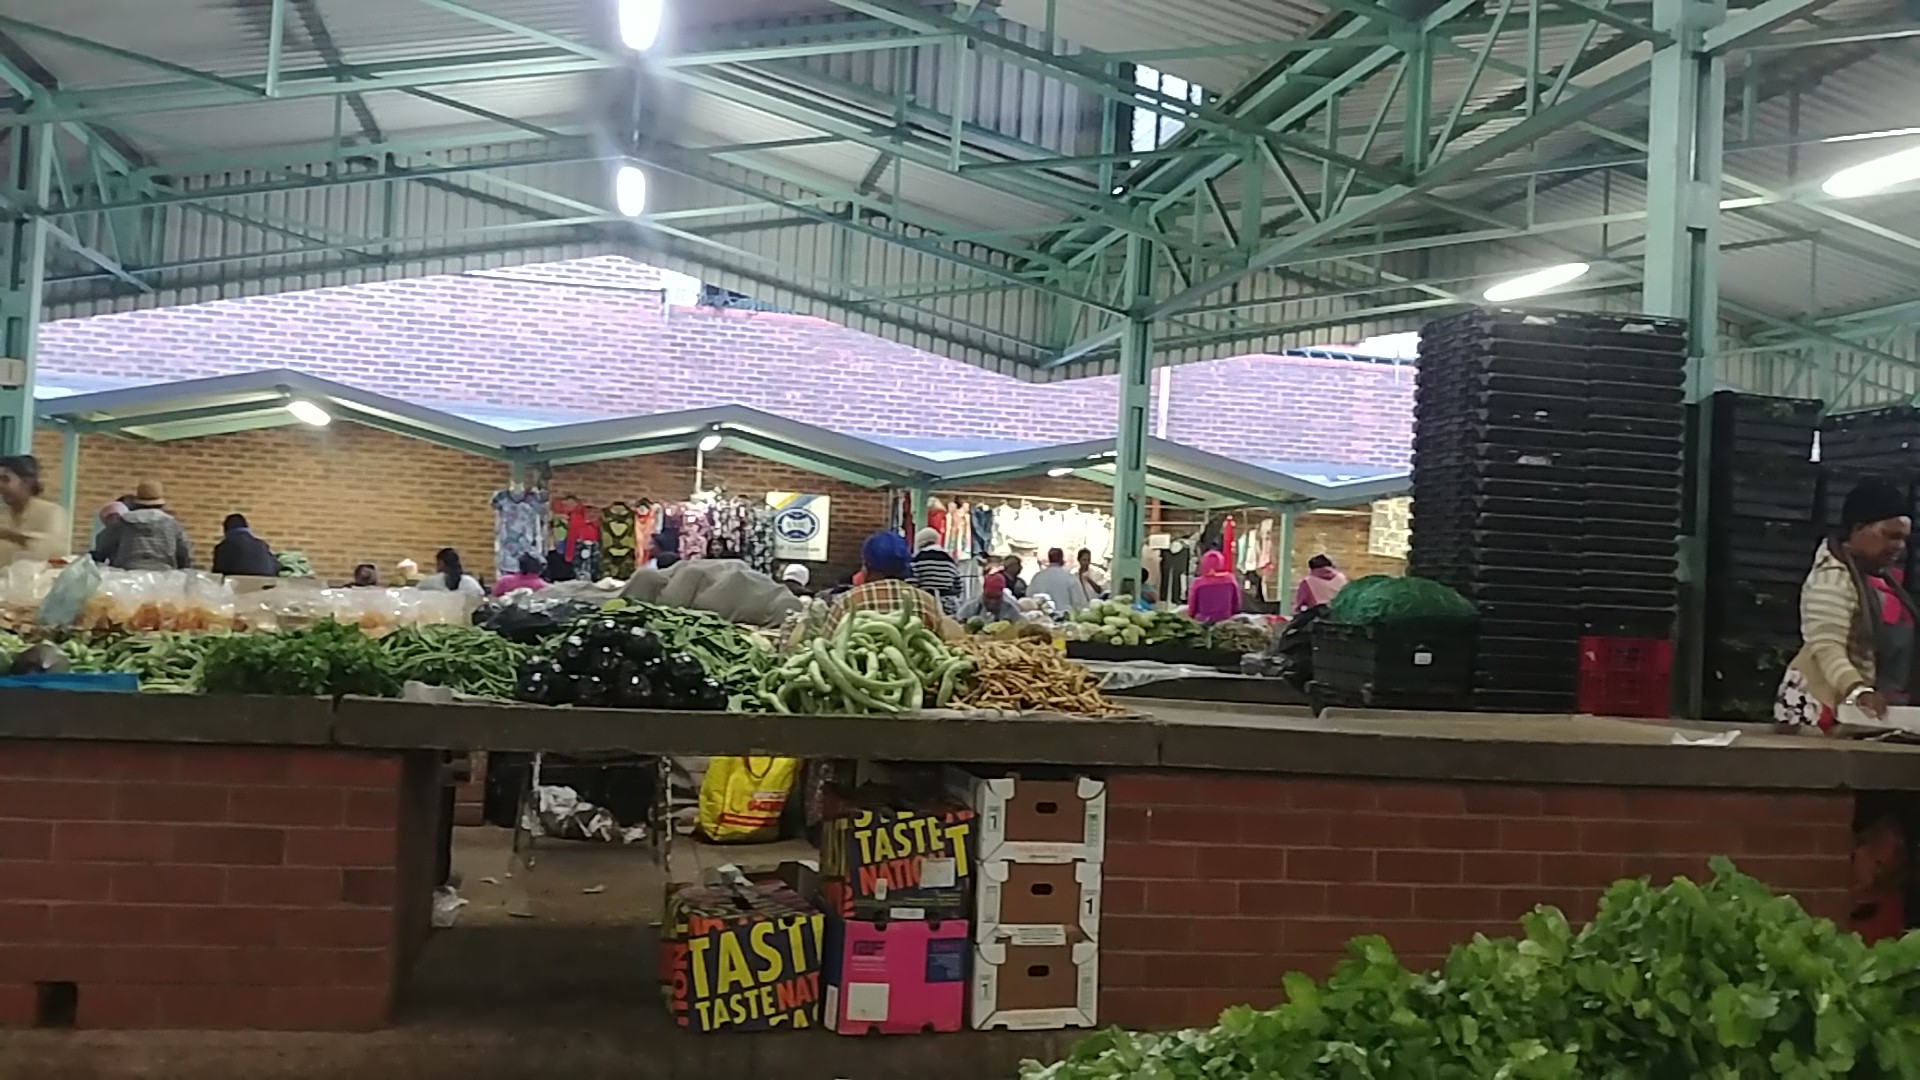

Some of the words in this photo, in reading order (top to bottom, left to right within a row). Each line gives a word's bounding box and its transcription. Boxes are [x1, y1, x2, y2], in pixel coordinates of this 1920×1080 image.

[854, 817, 945, 864] TASTE
[1085, 898, 1093, 914] 1
[695, 986, 776, 1031] TASTE
